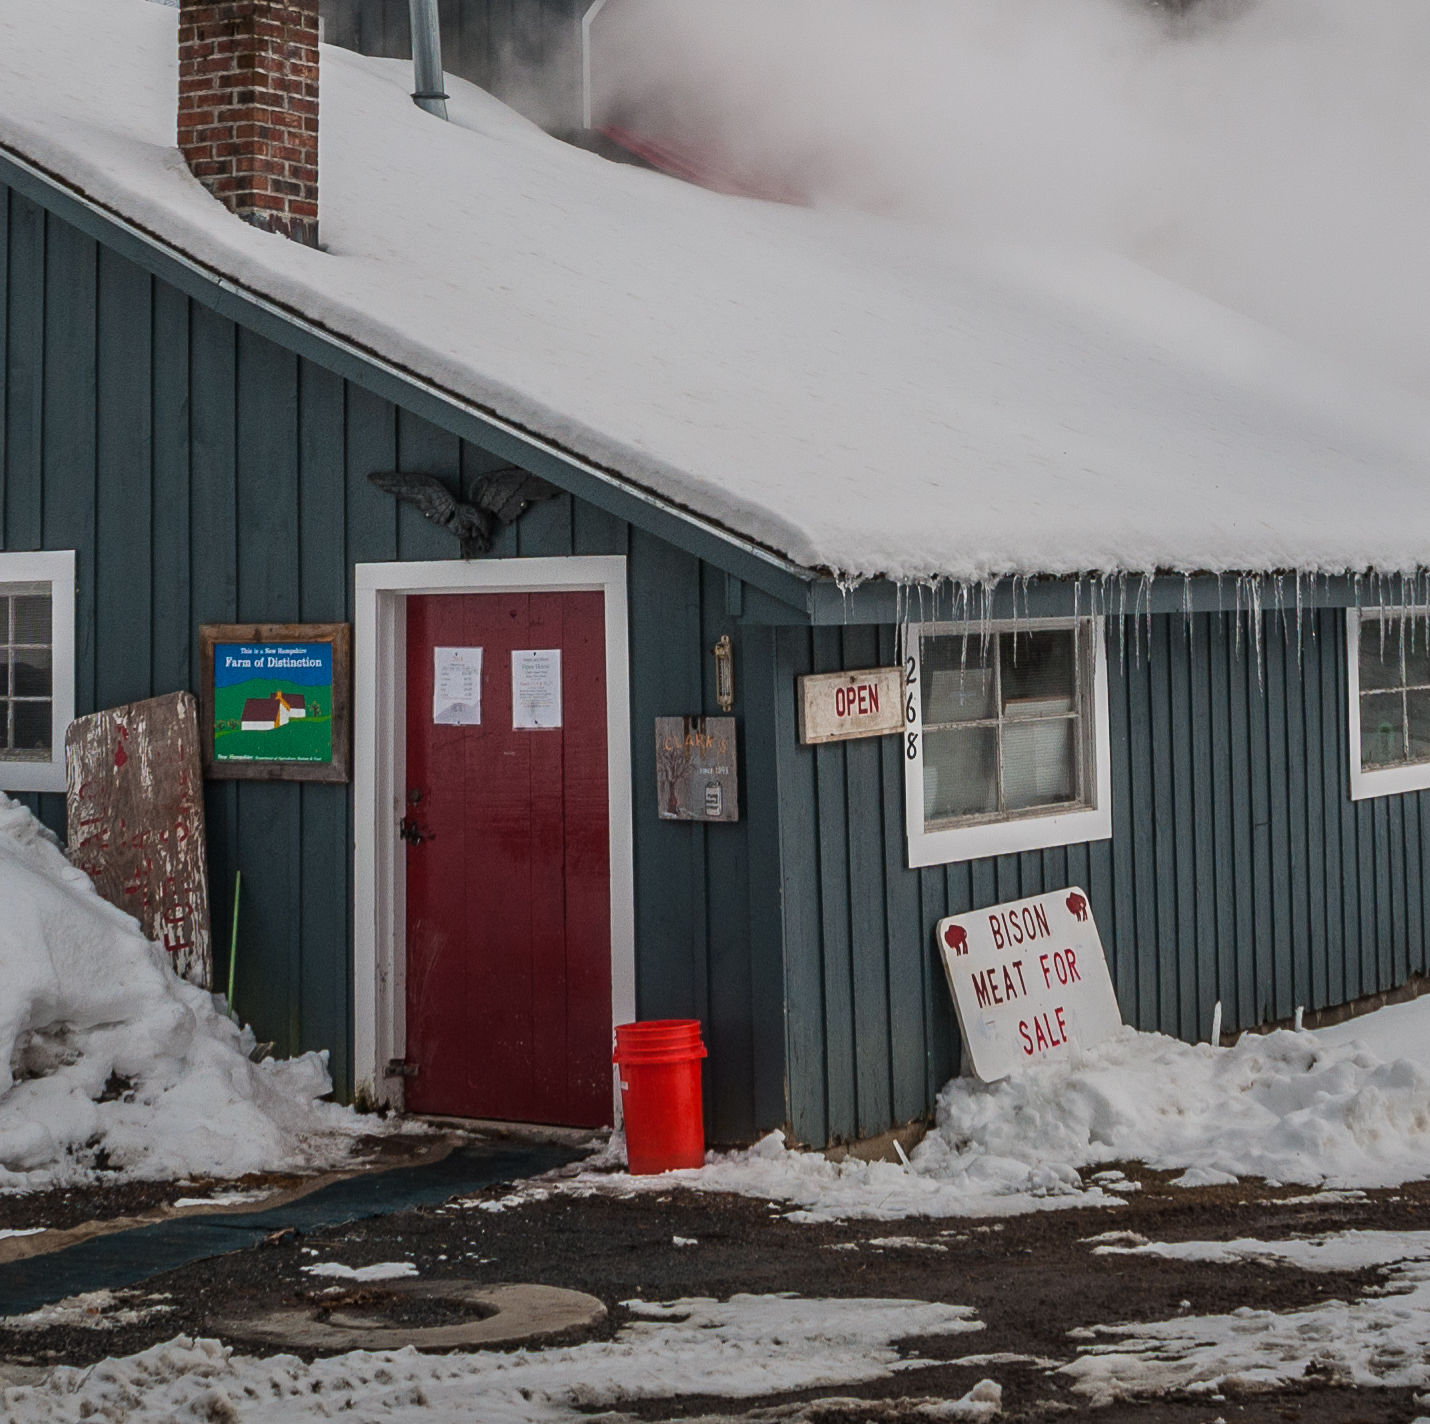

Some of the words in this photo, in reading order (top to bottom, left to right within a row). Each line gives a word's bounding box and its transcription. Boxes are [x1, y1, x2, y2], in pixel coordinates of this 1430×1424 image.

[225, 657, 251, 667] Farm
[254, 657, 264, 667] of
[267, 657, 322, 667] Distinction
[835, 683, 880, 717] OPEN
[988, 903, 1051, 950] BISON
[971, 960, 1028, 1009] MEAT
[1039, 948, 1082, 990] FOR
[1018, 1006, 1068, 1056] SALE
